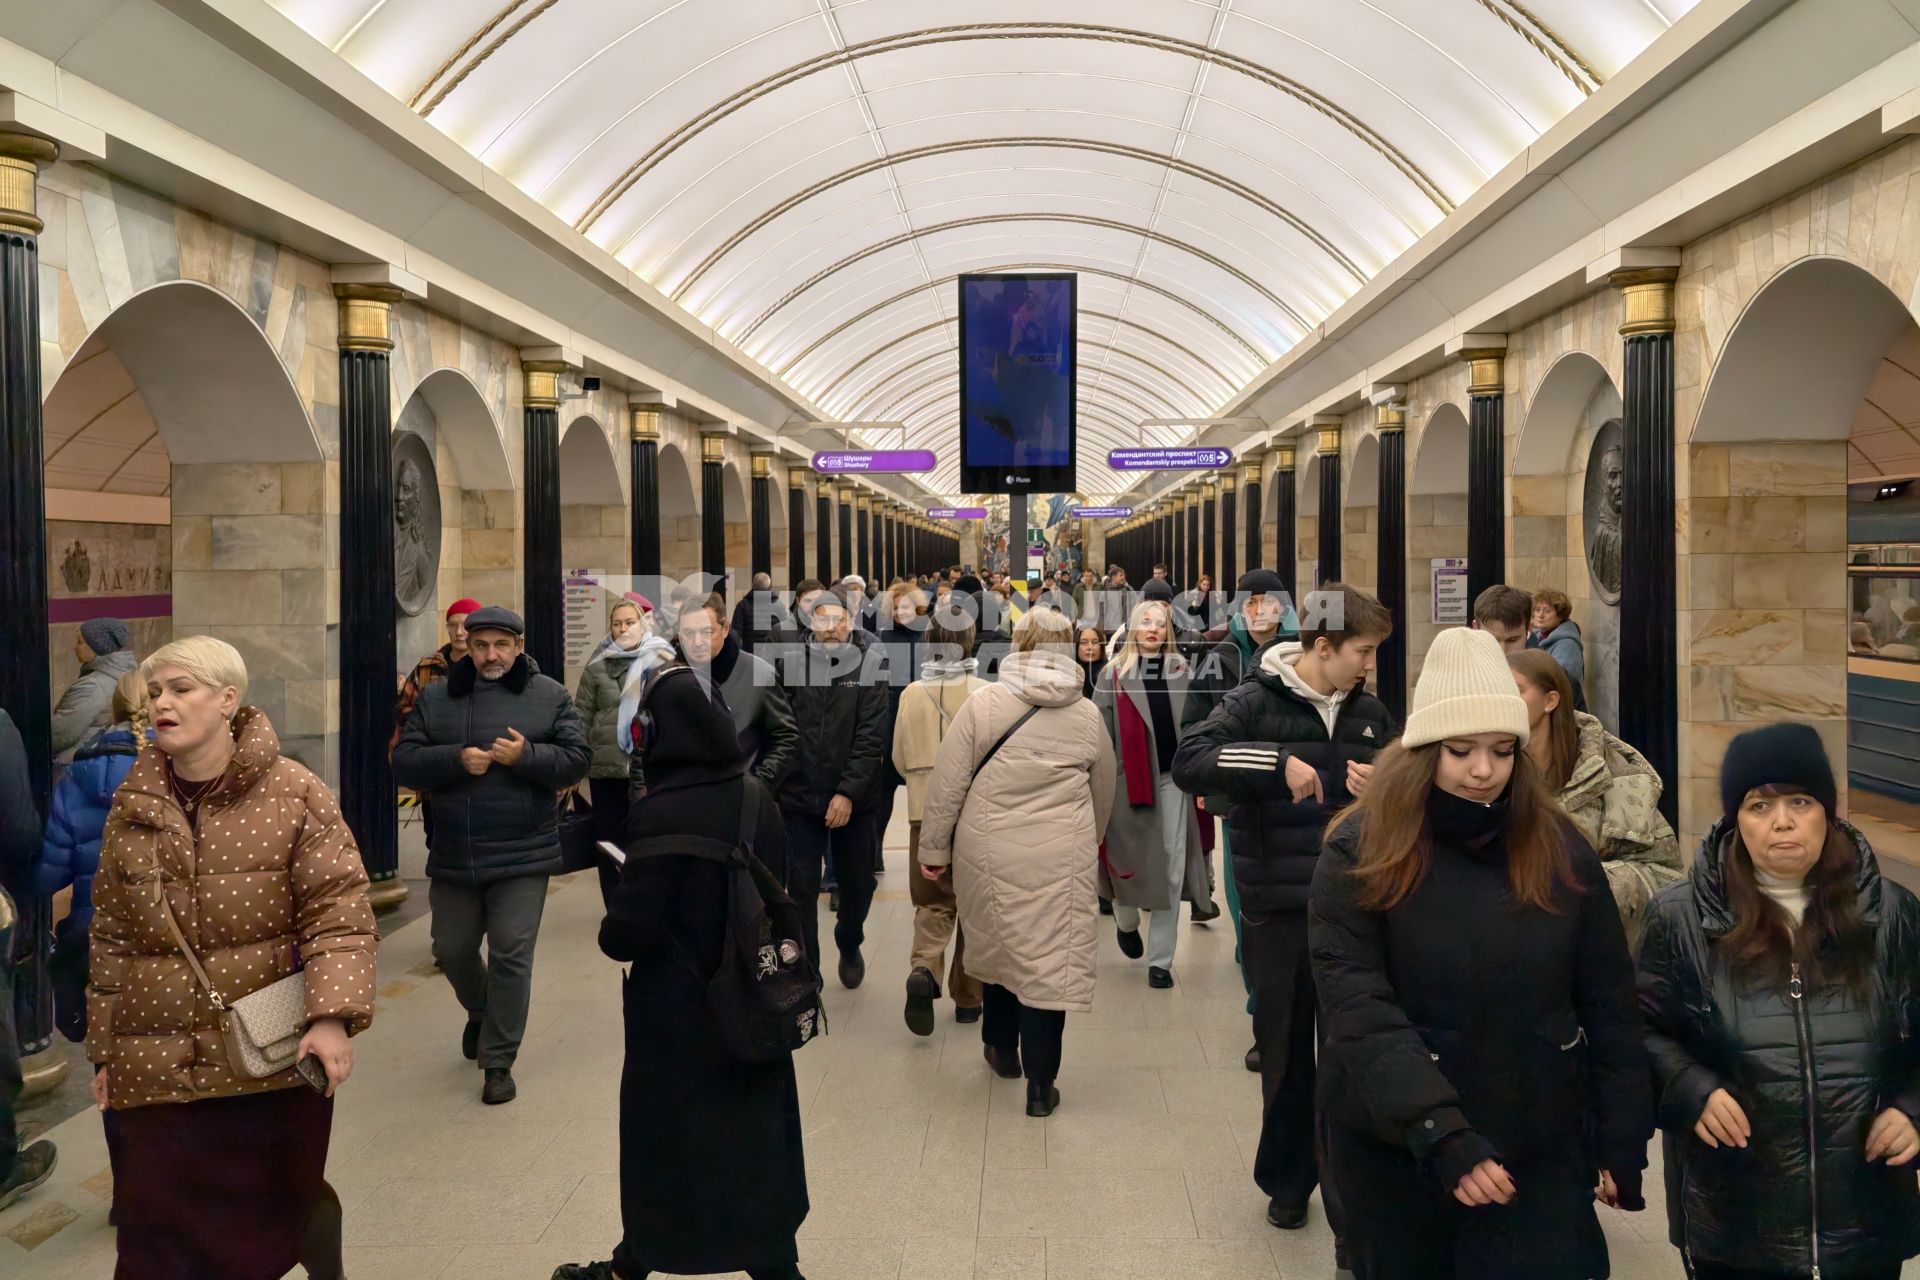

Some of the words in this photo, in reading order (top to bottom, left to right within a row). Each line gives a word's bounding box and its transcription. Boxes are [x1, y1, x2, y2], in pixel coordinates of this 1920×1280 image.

[1111, 451, 1164, 459] Комендантский
[1165, 451, 1197, 459] проспект
[1124, 459, 1170, 467] Komendantskiy
[1170, 458, 1197, 466] prospekt
